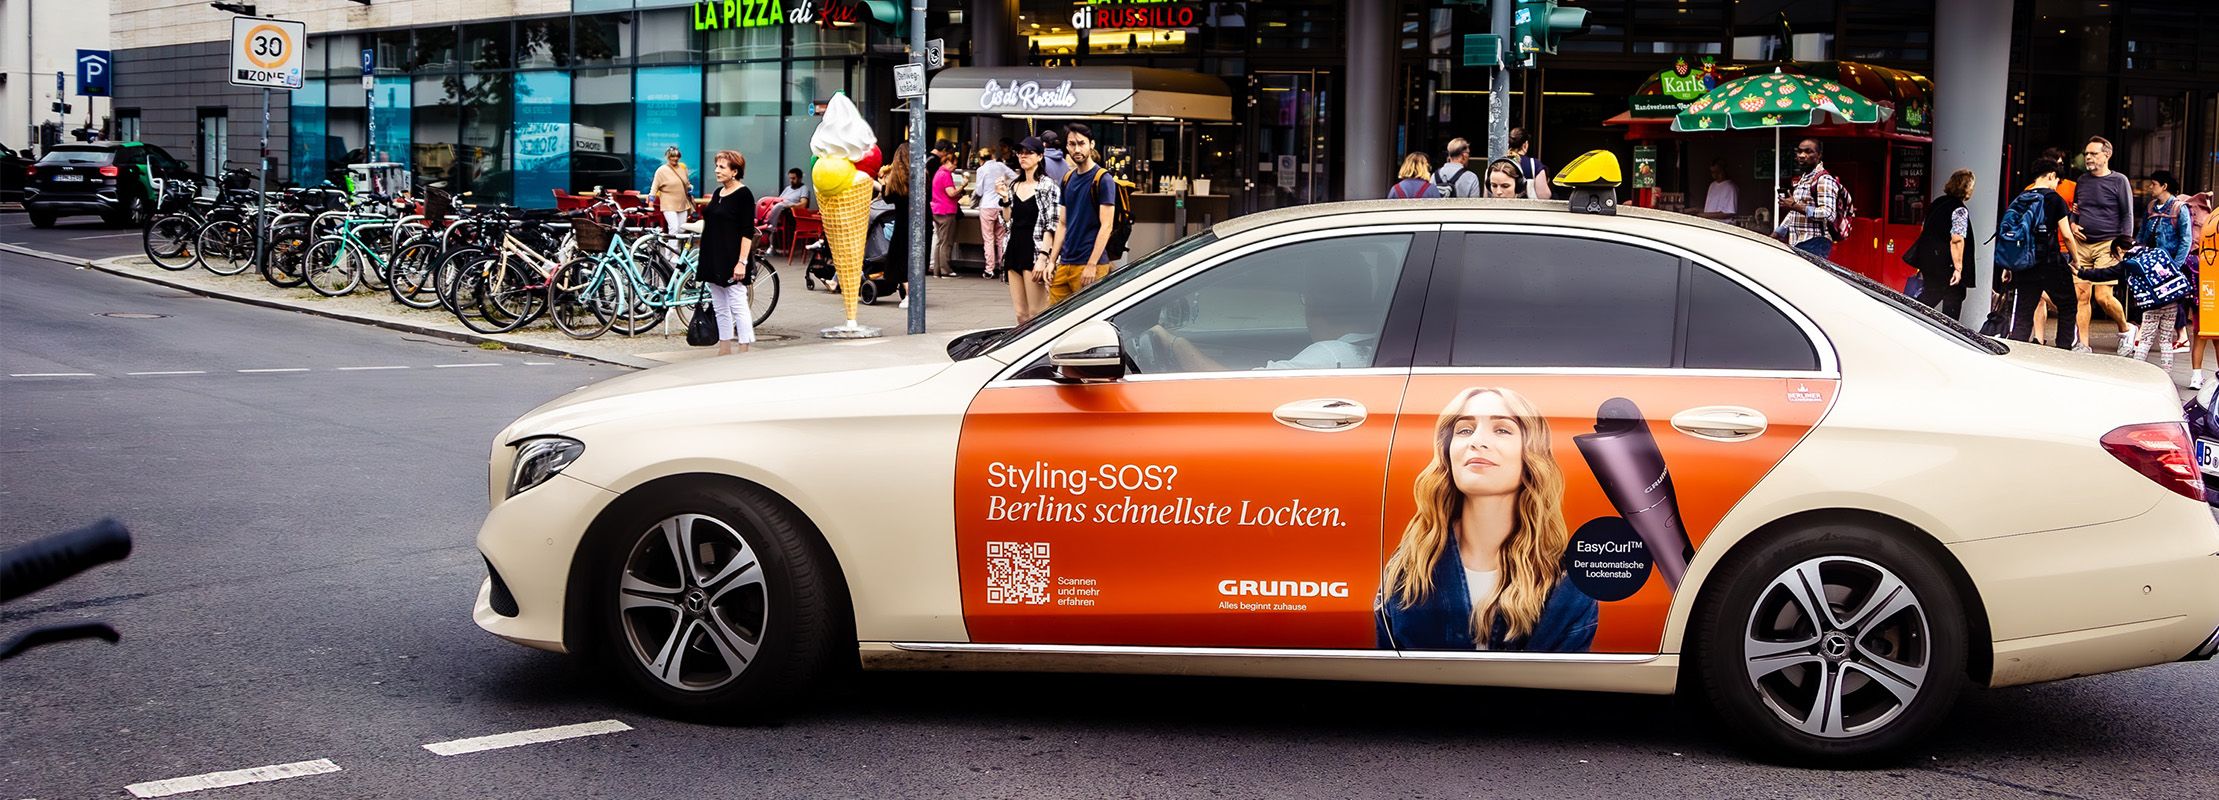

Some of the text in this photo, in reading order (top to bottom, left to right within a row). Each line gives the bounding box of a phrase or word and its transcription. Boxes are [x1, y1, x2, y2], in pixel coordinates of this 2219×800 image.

[694, 2, 718, 30] LA
[723, 0, 784, 29] PIZZA
[789, 0, 813, 24] di
[1072, 6, 1194, 29] di RUSSILLO
[254, 36, 282, 57] 30
[87, 62, 102, 83] P
[1664, 75, 1706, 93] Karls
[981, 79, 1076, 110] Eis di Russillo
[2204, 446, 2212, 466] B
[987, 460, 1178, 496] Styling-SOS?
[986, 494, 1347, 527] Berlins schnellste Locken.
[1574, 560, 1644, 569] Der automatische
[1585, 569, 1632, 579] Lockenstab
[1057, 576, 1097, 586] Scannen
[1218, 579, 1349, 598] GRUNDIG
[1057, 586, 1101, 596] und mehr
[1057, 596, 1095, 606] erfahren
[1218, 601, 1307, 612] Alles beginnt zuhause
